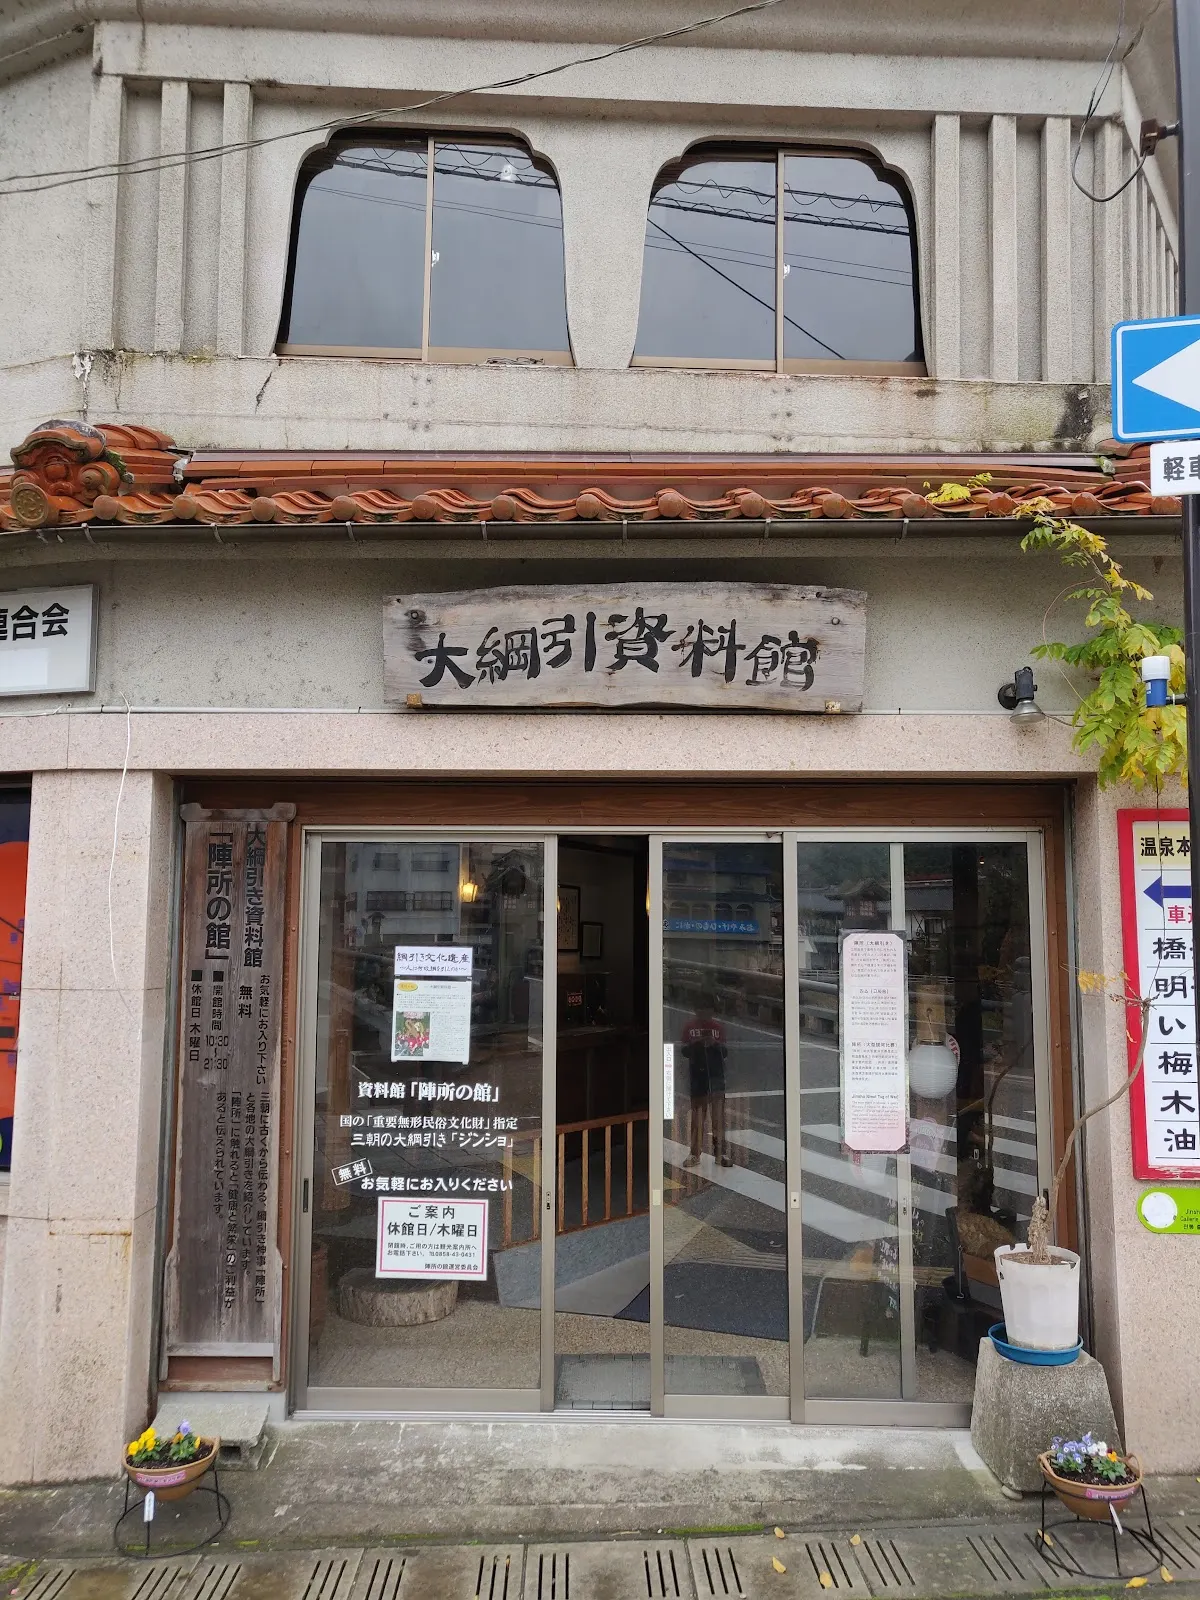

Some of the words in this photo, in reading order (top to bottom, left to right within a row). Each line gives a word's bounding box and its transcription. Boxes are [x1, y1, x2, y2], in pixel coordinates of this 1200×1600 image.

[414, 607, 821, 691] 大綱引資料館
[205, 832, 234, 961] 「陣所の館」
[244, 825, 267, 968] 大綱引き資料館
[1167, 905, 1192, 924] 車
[191, 984, 202, 1018] 休館日
[238, 985, 253, 1019] 無料
[189, 1022, 201, 1062] 木曜日
[256, 974, 270, 1085] お気軽にお入り下さい
[1157, 1050, 1193, 1076] 梅
[358, 1081, 500, 1103] 資料館「陣所の館」
[1160, 1089, 1196, 1114] 木
[340, 1114, 518, 1130] 国の「重要無形民俗文化財」指定
[1163, 1127, 1196, 1152] 油
[338, 1161, 367, 1182] 無料
[361, 1177, 512, 1192] お気軽にお入りください
[408, 1204, 455, 1220] ご案内
